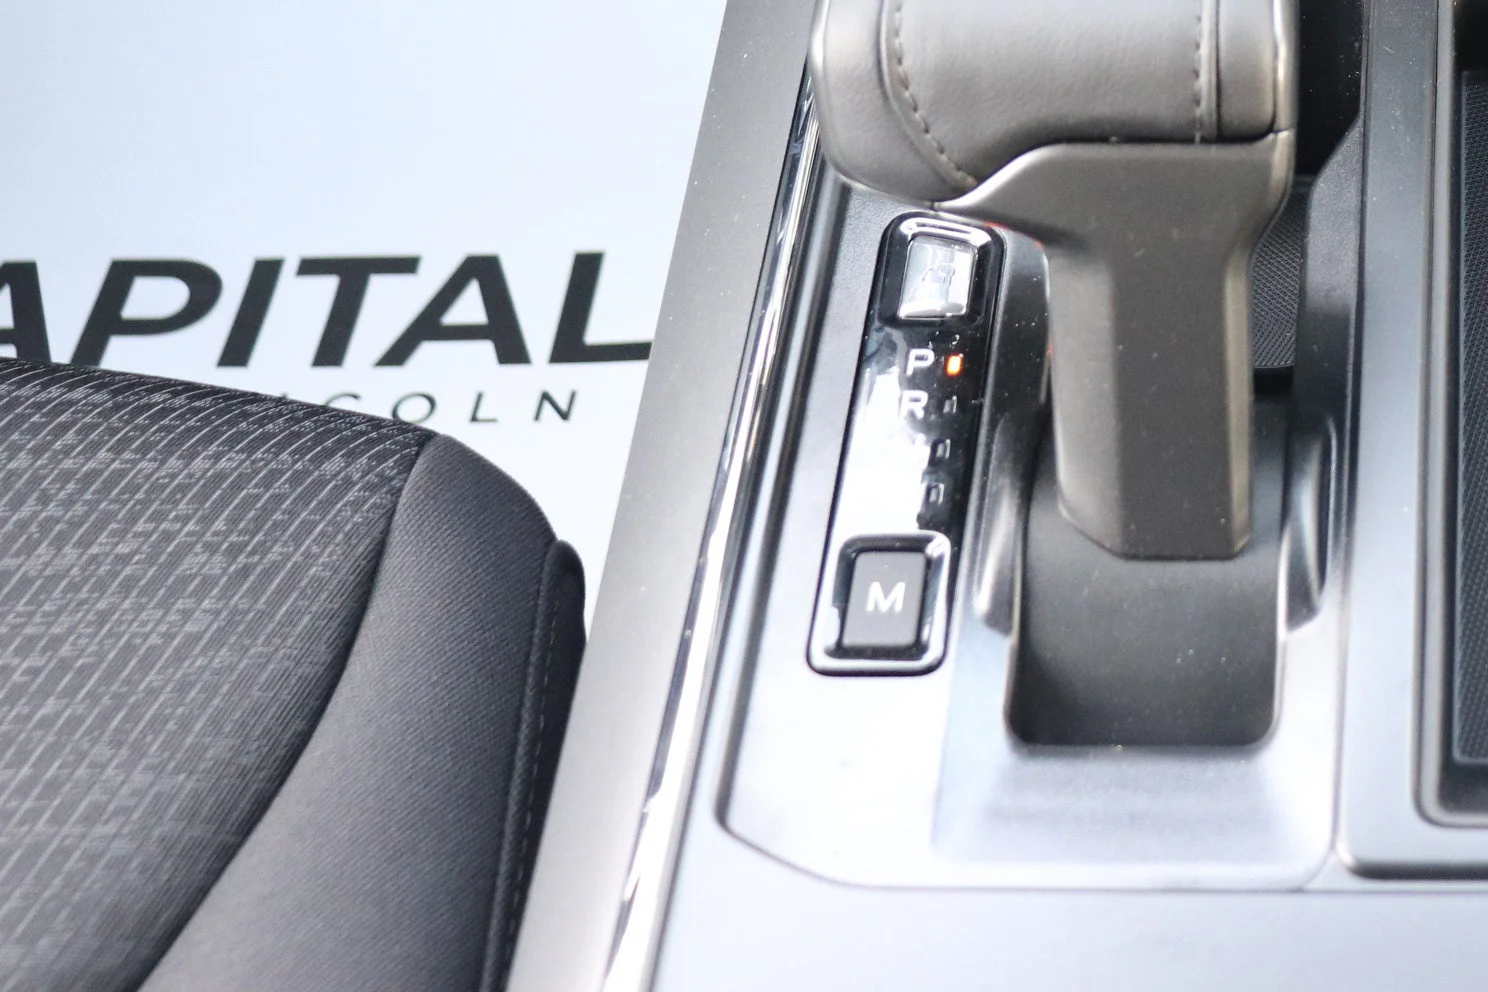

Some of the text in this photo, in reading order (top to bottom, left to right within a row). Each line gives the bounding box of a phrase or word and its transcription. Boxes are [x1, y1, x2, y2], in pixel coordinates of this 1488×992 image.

[906, 348, 935, 377] P
[899, 389, 929, 419] R
[866, 581, 906, 613] M
